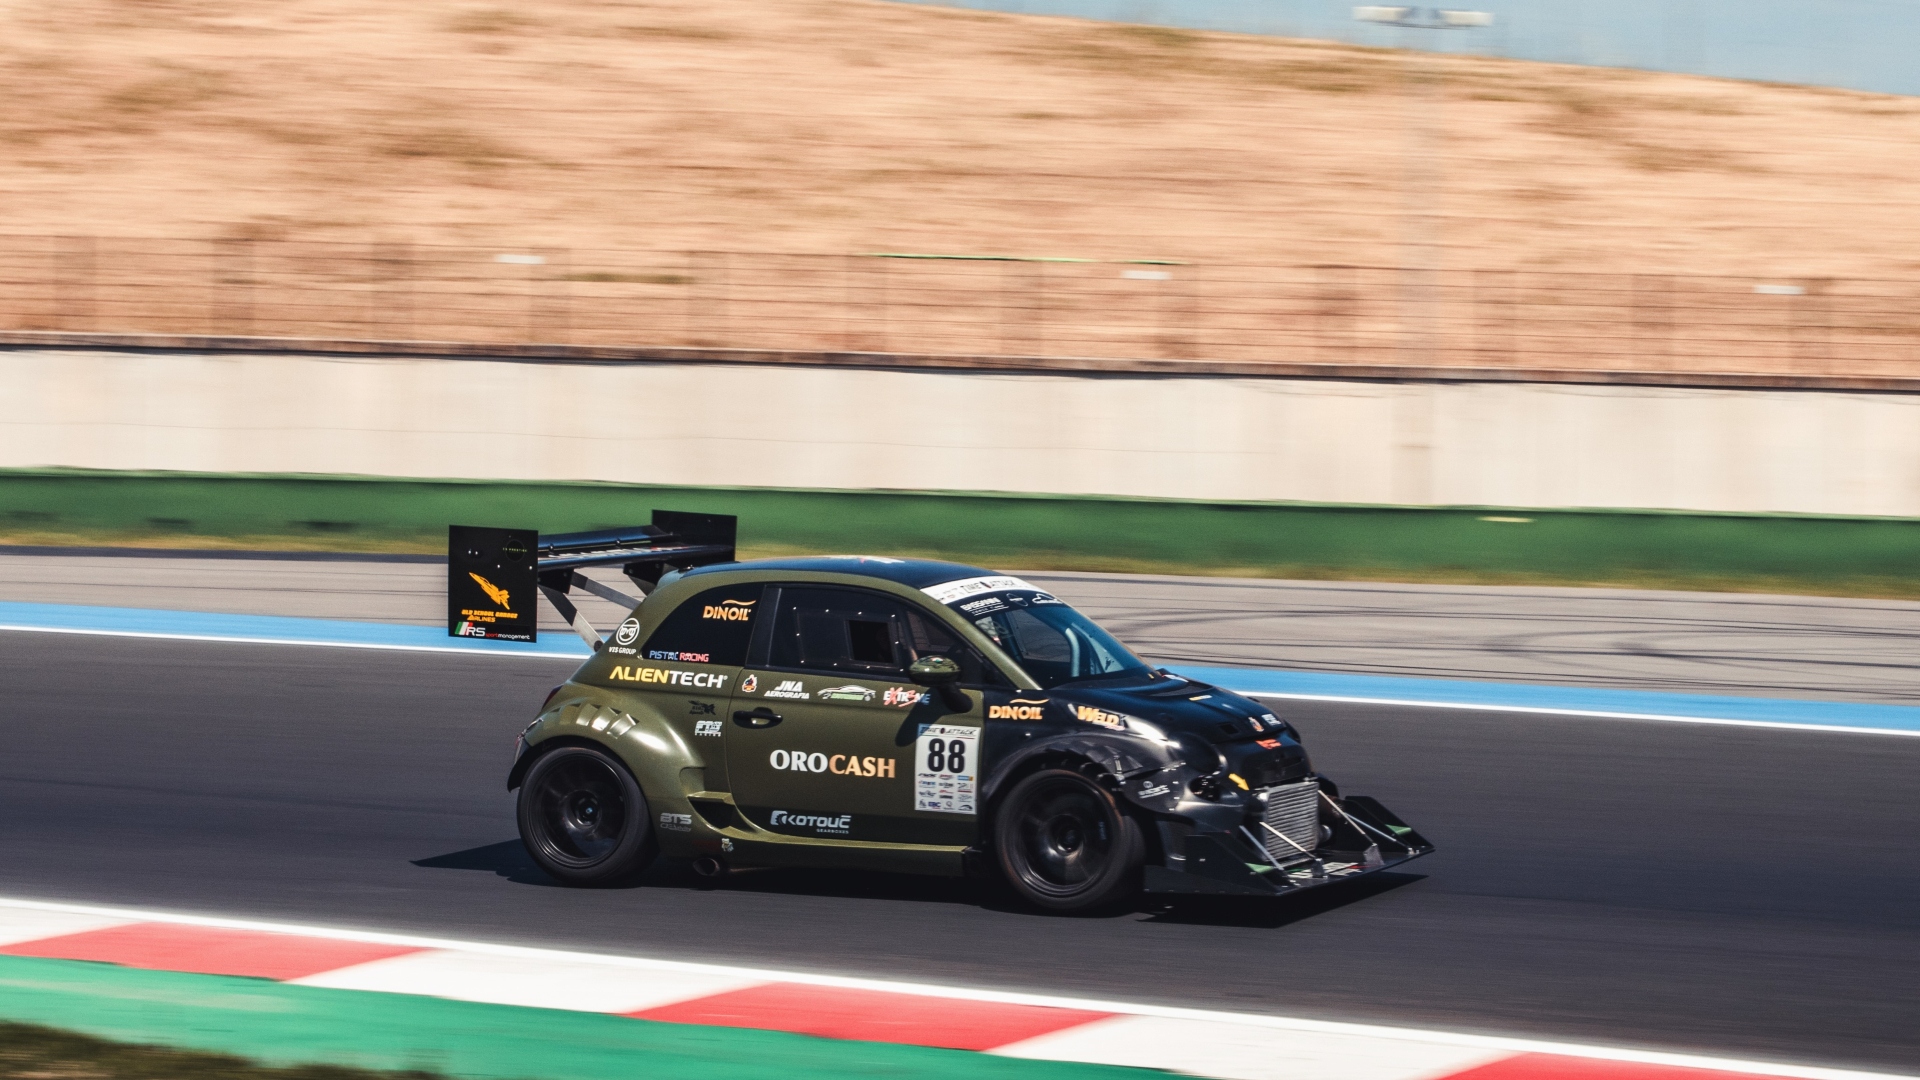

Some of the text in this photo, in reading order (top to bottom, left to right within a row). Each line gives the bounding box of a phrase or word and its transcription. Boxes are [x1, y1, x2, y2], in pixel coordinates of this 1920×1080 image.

[467, 614, 496, 622] AIRLINES
[703, 605, 750, 621] DINOIL
[618, 647, 637, 655] GROUP
[774, 680, 803, 692] JNA
[764, 691, 810, 699] AEROGRAFIA
[988, 705, 1043, 720] DINOIL
[928, 738, 966, 774] 88
[769, 749, 896, 778] OROCASH
[660, 812, 693, 825] BTS
